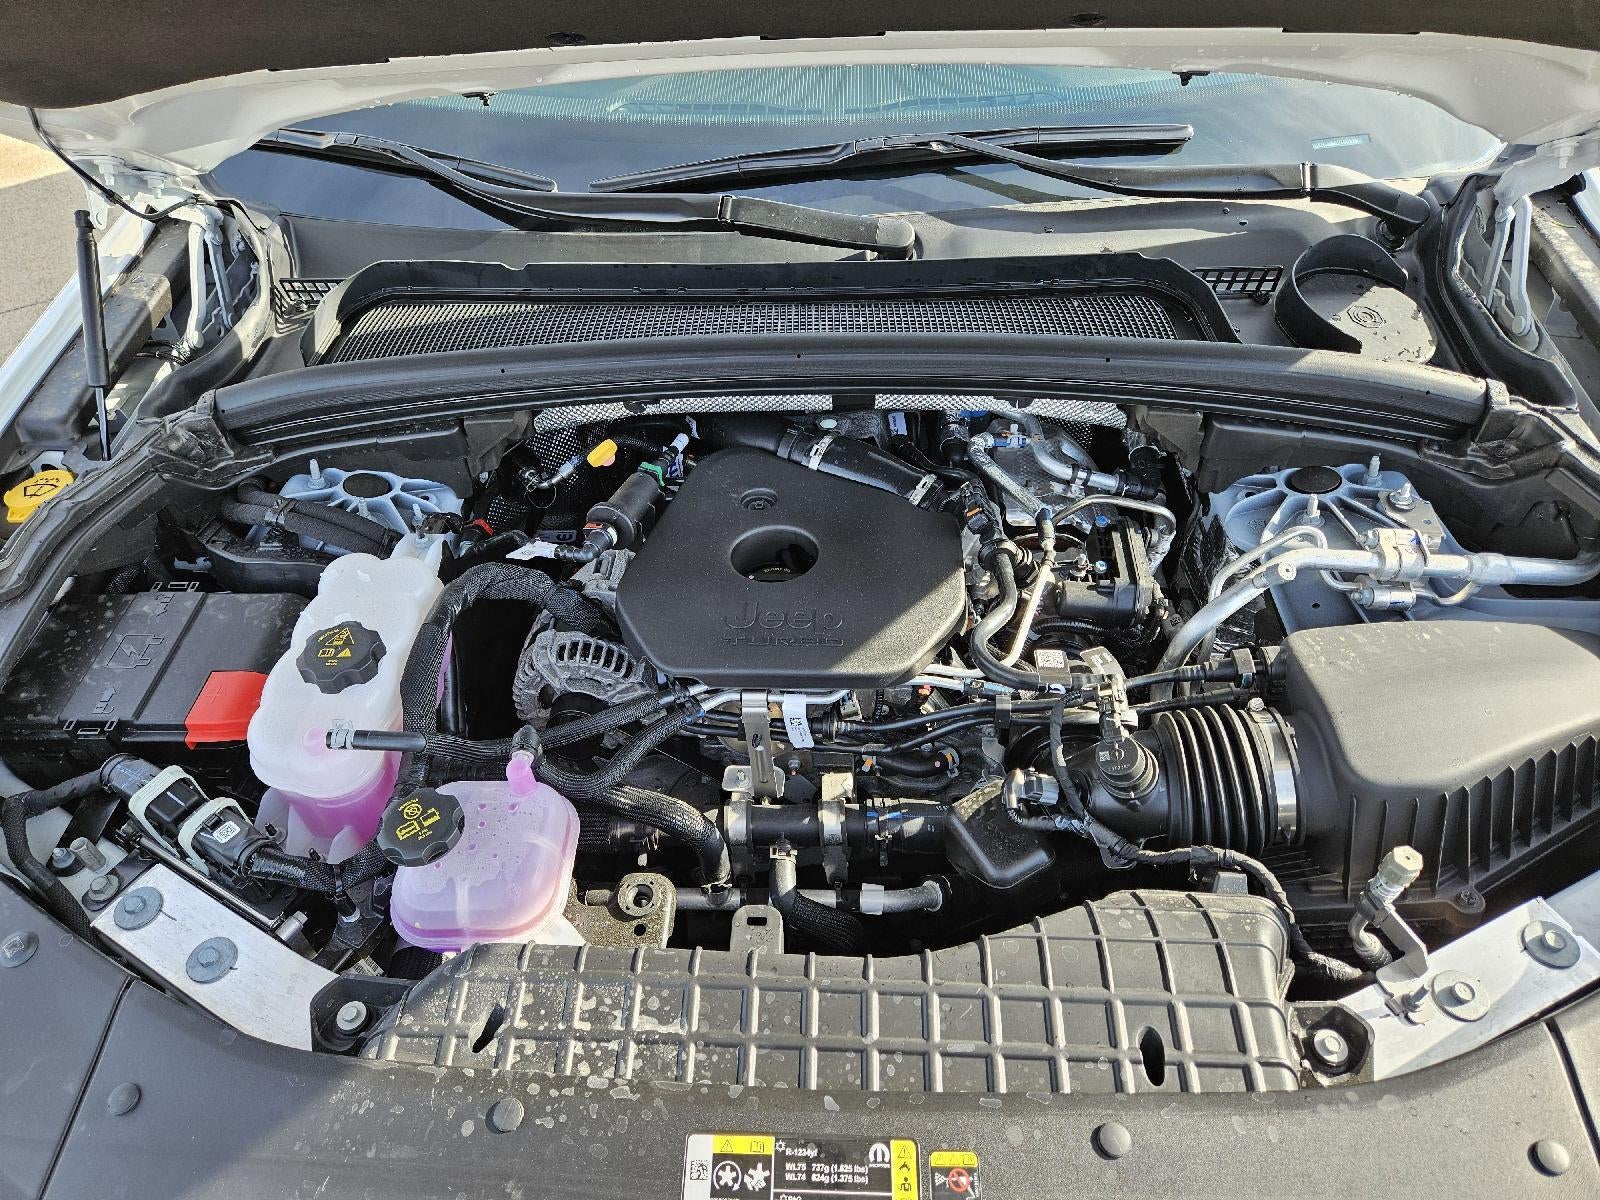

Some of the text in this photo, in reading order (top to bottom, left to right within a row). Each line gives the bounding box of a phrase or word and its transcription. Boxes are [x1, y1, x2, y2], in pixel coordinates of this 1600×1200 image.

[726, 602, 843, 634] Jeep
[785, 1147, 818, 1158] R-1234yf
[785, 1162, 869, 1175] WL75 737g (1.625 lbs)
[785, 1172, 807, 1181] WL74
[831, 1174, 853, 1184] (1.375
[854, 1175, 869, 1185] lbs)
